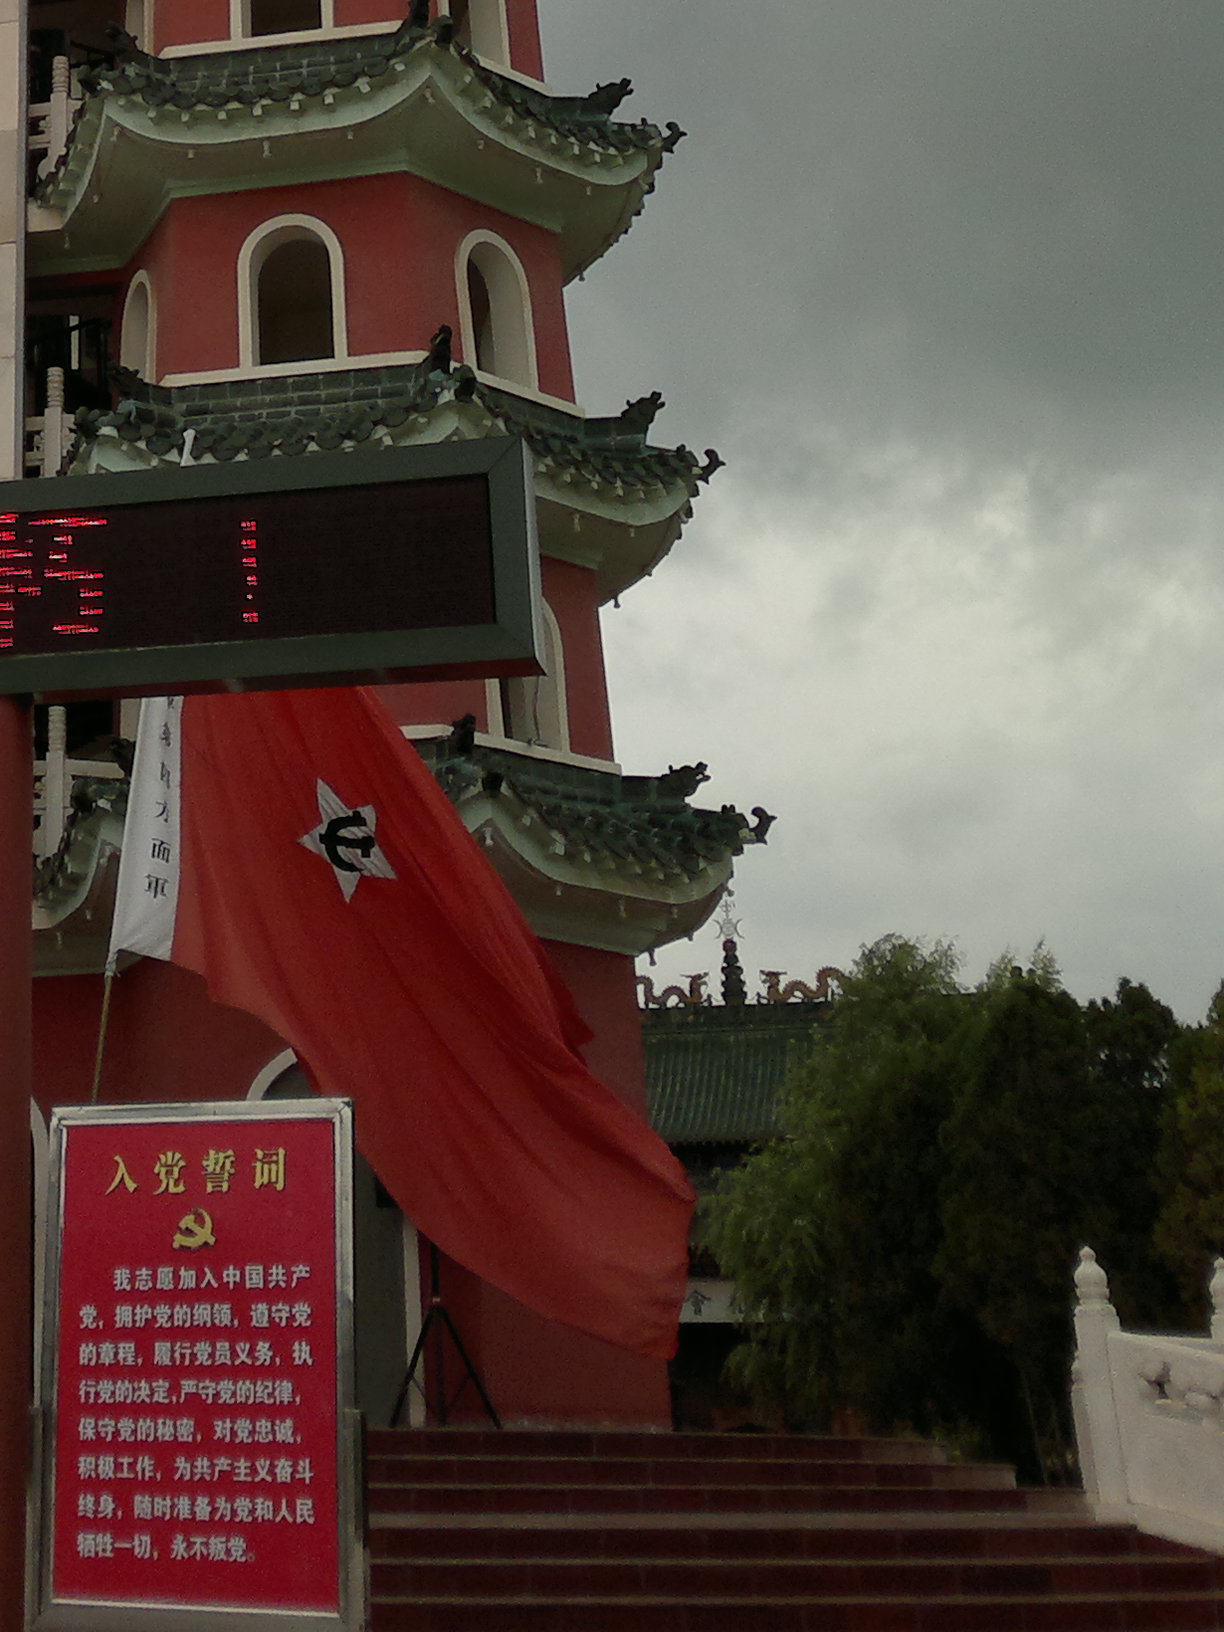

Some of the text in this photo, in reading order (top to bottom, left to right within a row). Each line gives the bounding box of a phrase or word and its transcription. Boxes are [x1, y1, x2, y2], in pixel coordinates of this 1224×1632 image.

[105, 1146, 287, 1196] 入党誓词
[113, 1264, 311, 1292] 我志愿加入中国共产
